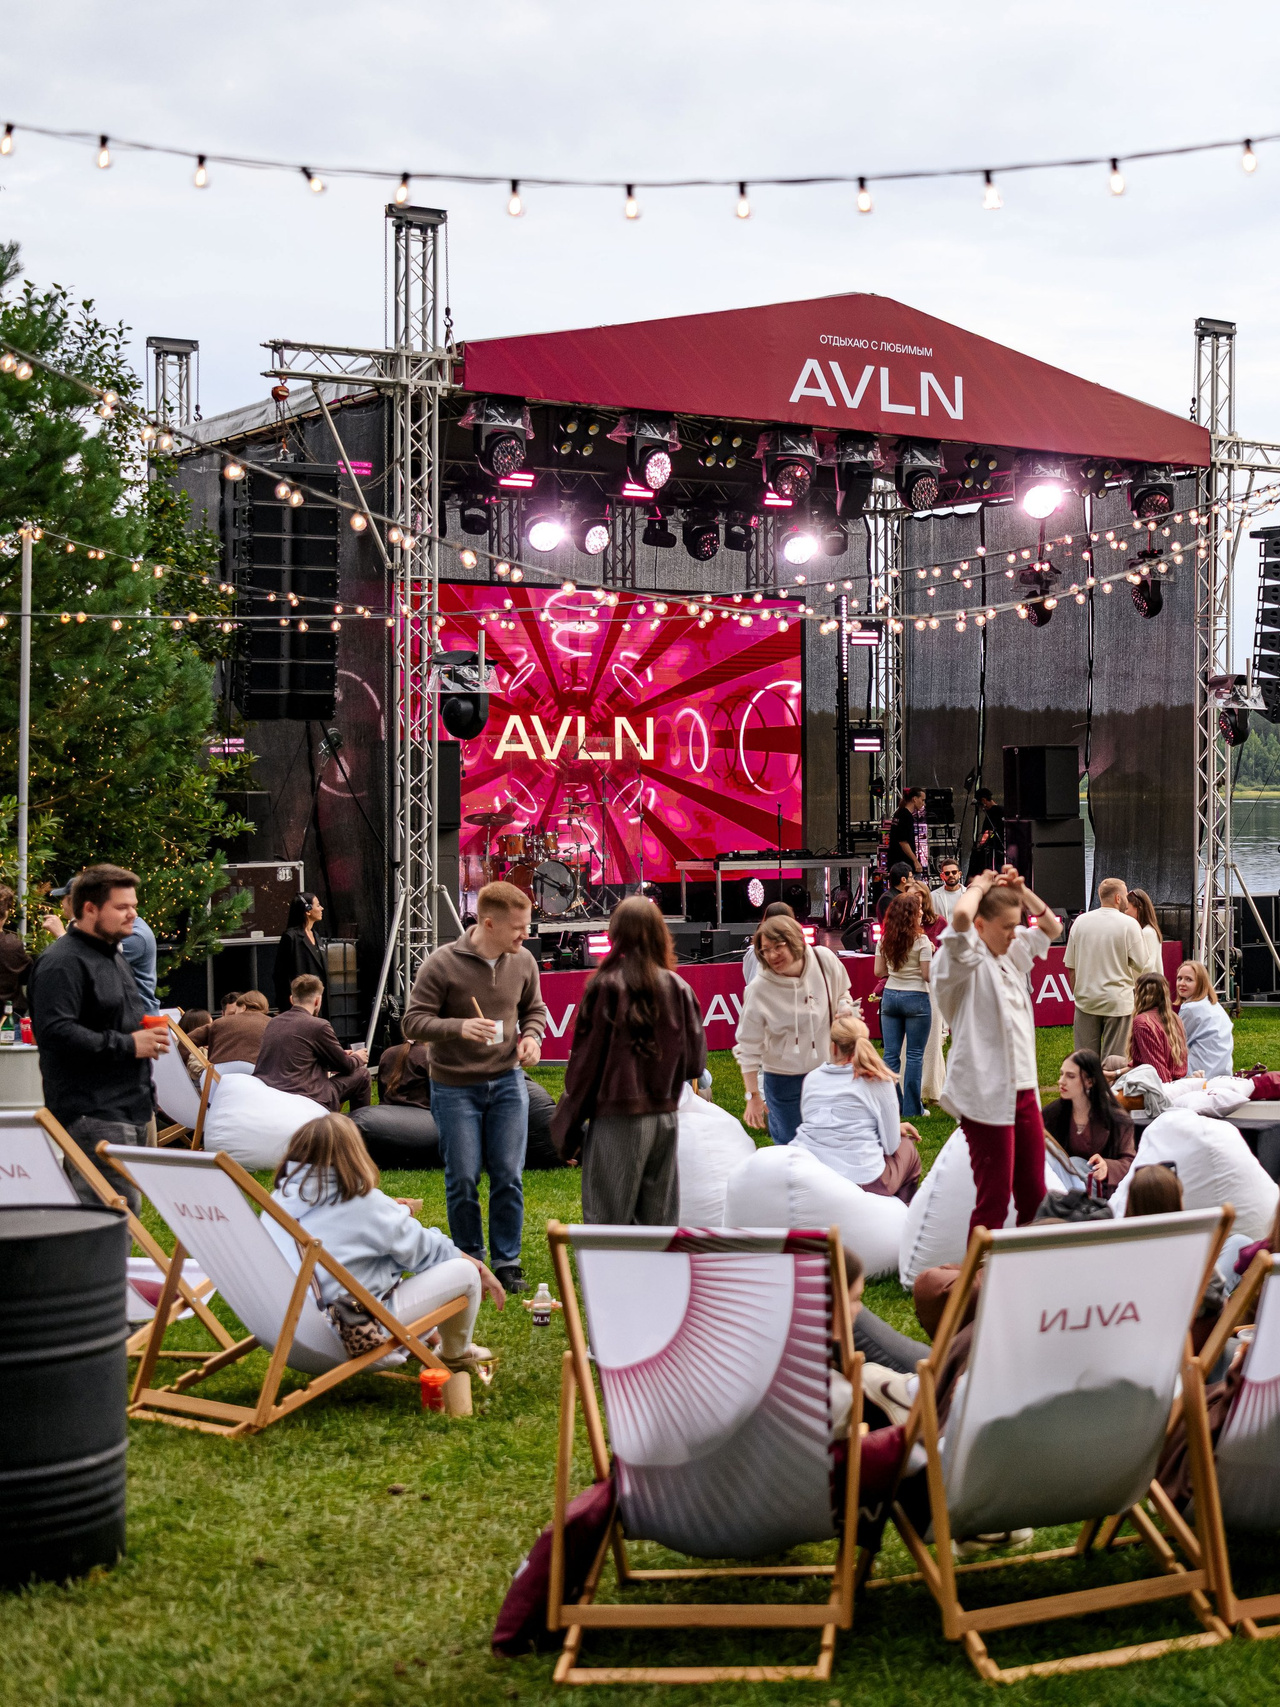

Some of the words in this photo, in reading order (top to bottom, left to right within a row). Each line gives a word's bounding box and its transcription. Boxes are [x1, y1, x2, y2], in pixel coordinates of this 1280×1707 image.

[819, 334, 869, 349] ОТДЫХАЮ
[870, 340, 879, 350] С
[879, 341, 933, 357] ЛЮБИМЫМ
[788, 358, 964, 420] AVLN
[493, 714, 655, 761] AVLN
